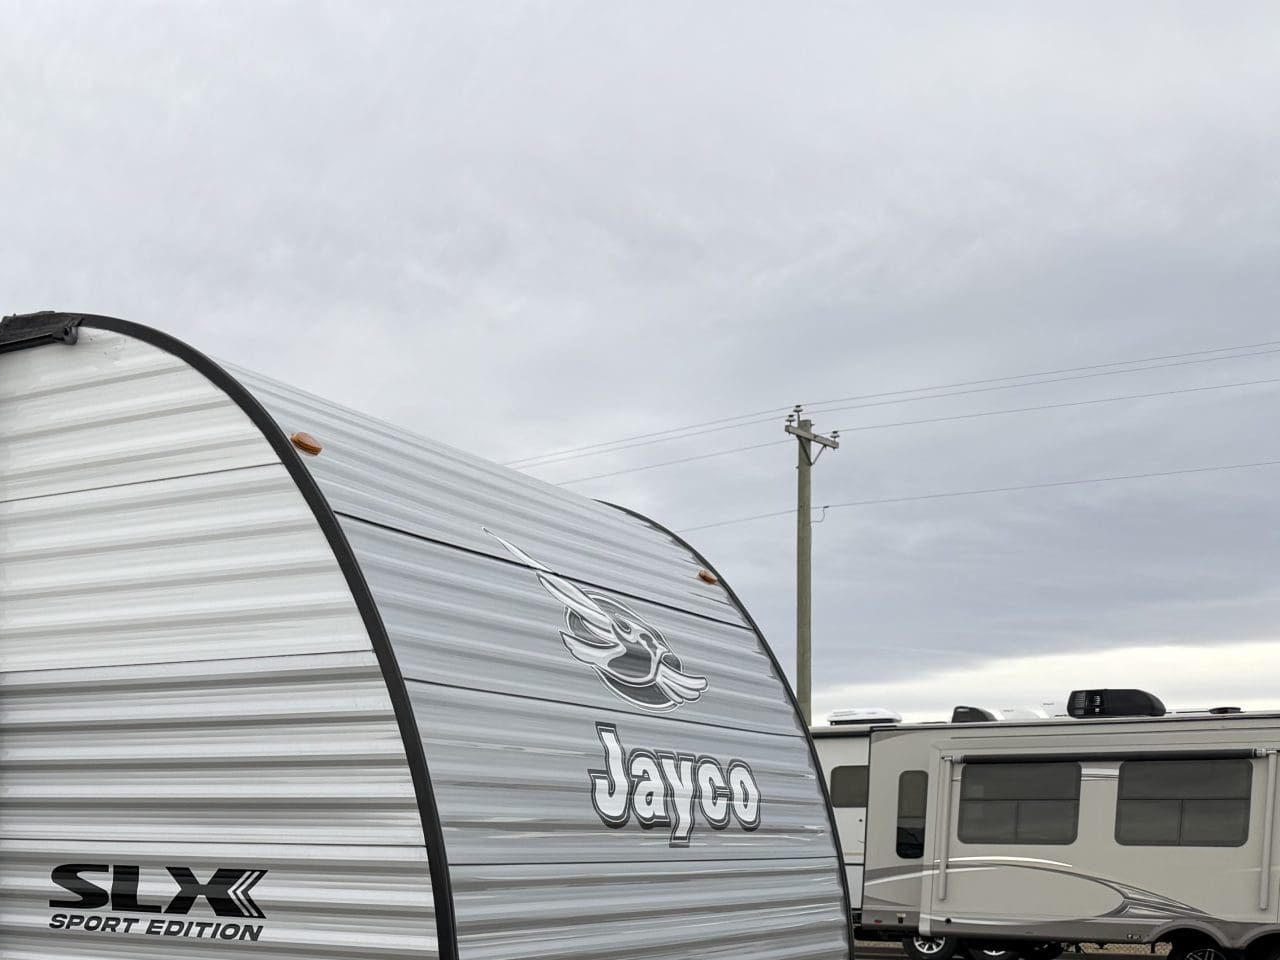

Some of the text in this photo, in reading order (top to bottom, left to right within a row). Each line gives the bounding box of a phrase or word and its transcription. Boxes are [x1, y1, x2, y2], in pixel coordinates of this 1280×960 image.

[587, 721, 761, 848] Jayco
[49, 863, 269, 919] SLX
[49, 913, 264, 941] SPORT EDITION
